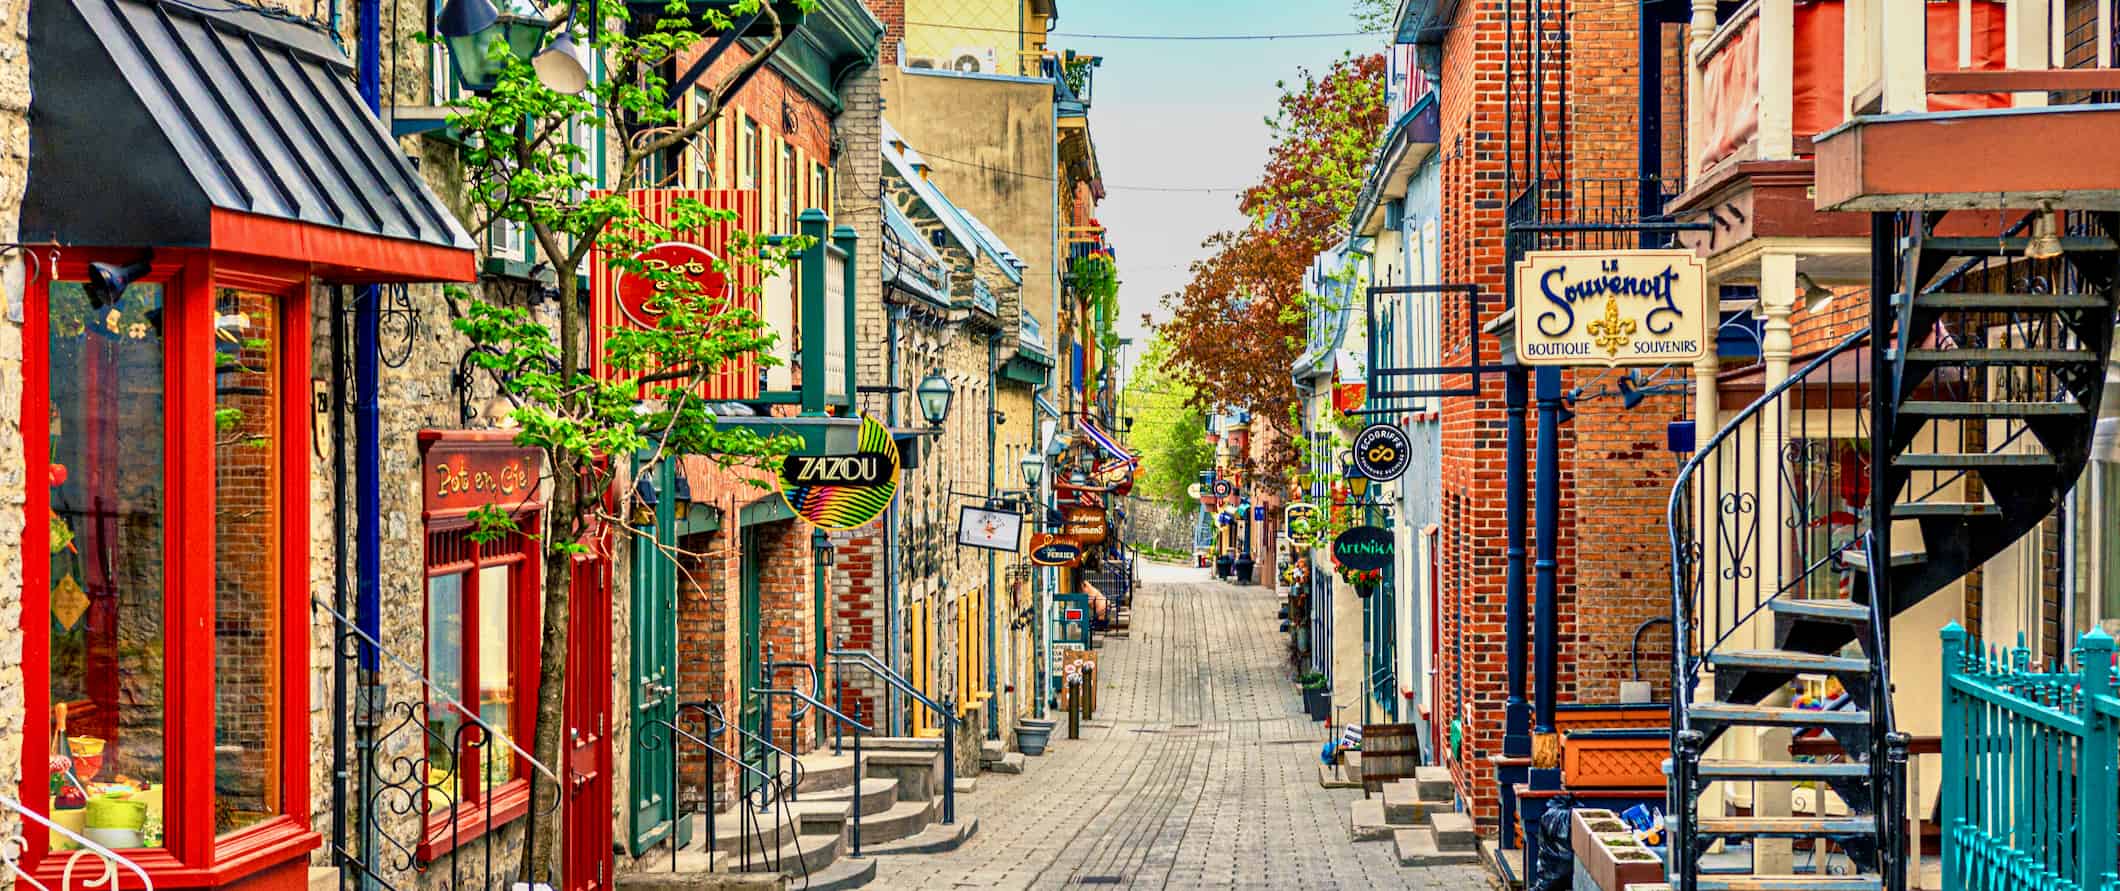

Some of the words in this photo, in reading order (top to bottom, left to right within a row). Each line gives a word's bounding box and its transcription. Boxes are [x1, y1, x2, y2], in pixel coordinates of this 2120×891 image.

[1528, 342, 1591, 355] BOUTIQUE
[1634, 340, 1697, 354] SOUVENIRS
[436, 460, 469, 496] Pot
[474, 471, 497, 493] en
[500, 456, 531, 494] Ciel
[797, 457, 877, 481] ZAZOU
